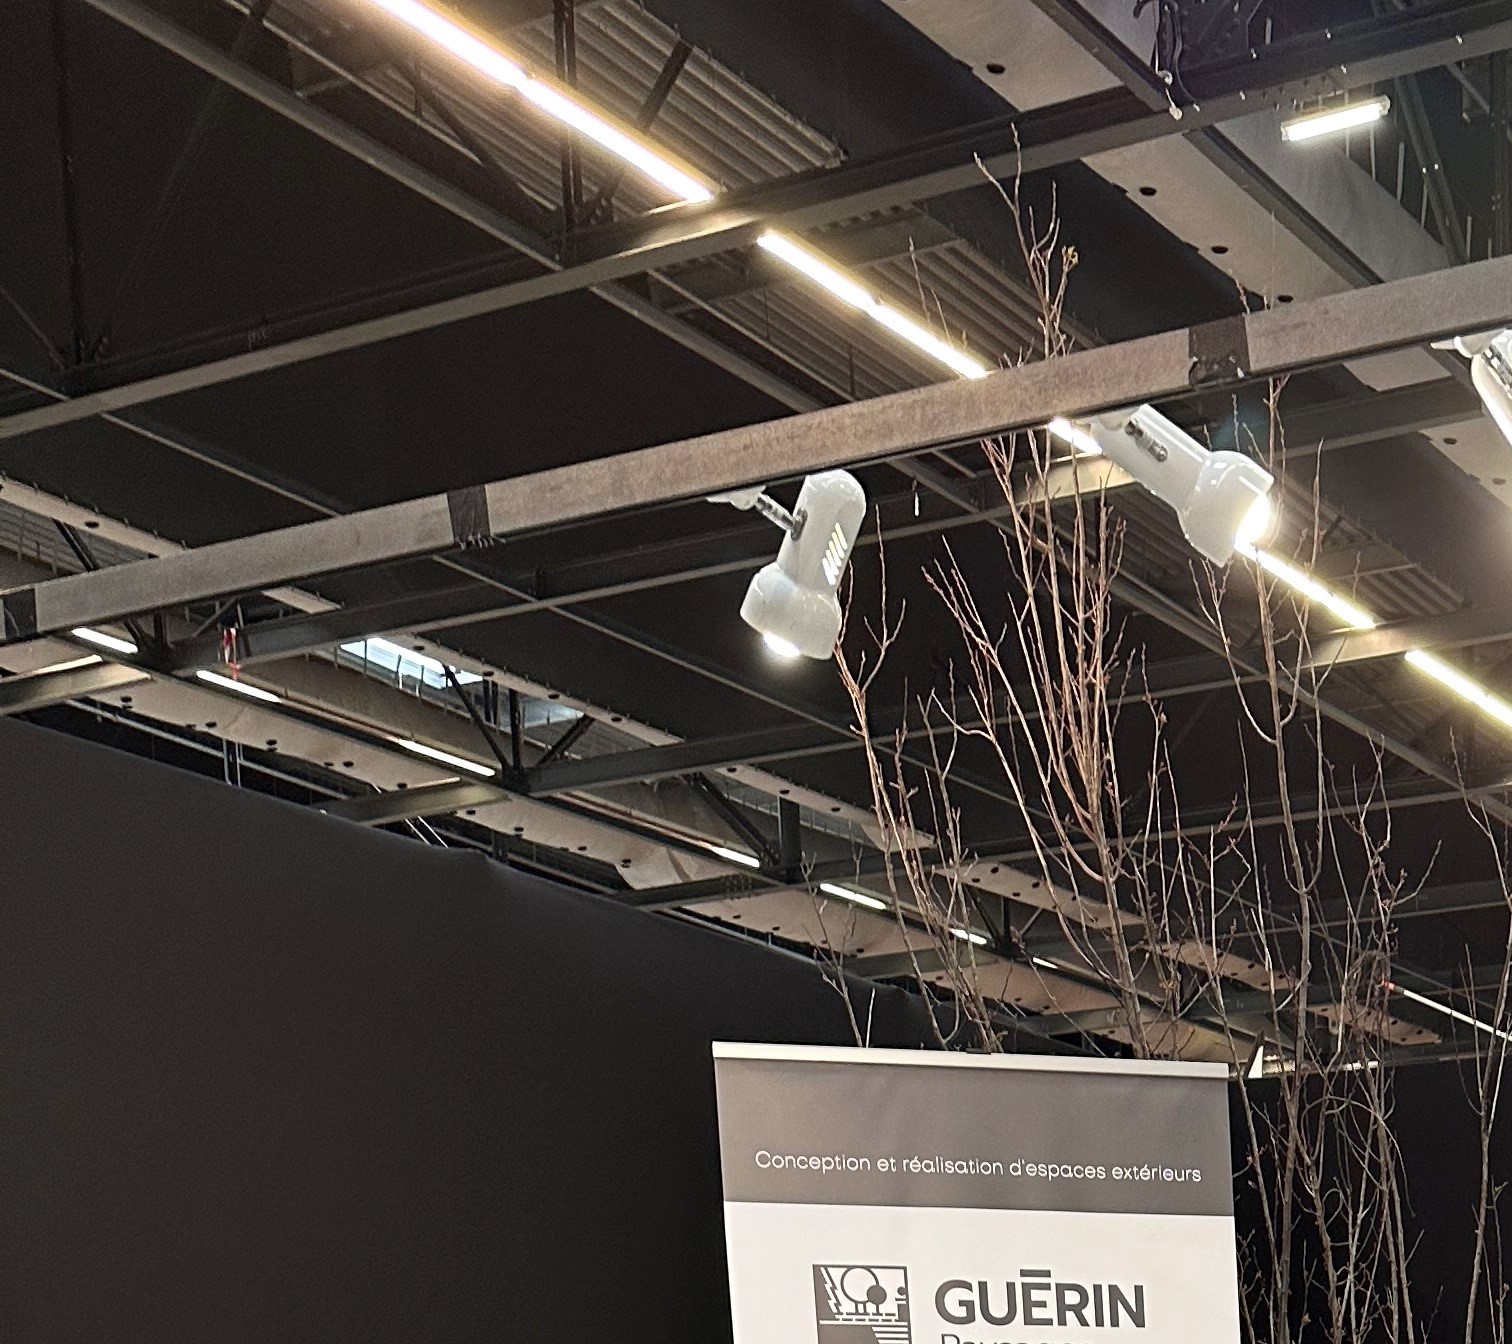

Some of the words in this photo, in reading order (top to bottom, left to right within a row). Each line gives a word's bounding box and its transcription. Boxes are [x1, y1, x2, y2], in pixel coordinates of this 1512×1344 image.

[755, 1150, 871, 1175] Conception
[876, 1156, 897, 1173] et
[902, 1156, 1004, 1176] réalisation
[1009, 1158, 1107, 1182] d'espaces
[1111, 1163, 1202, 1183] extérieurs
